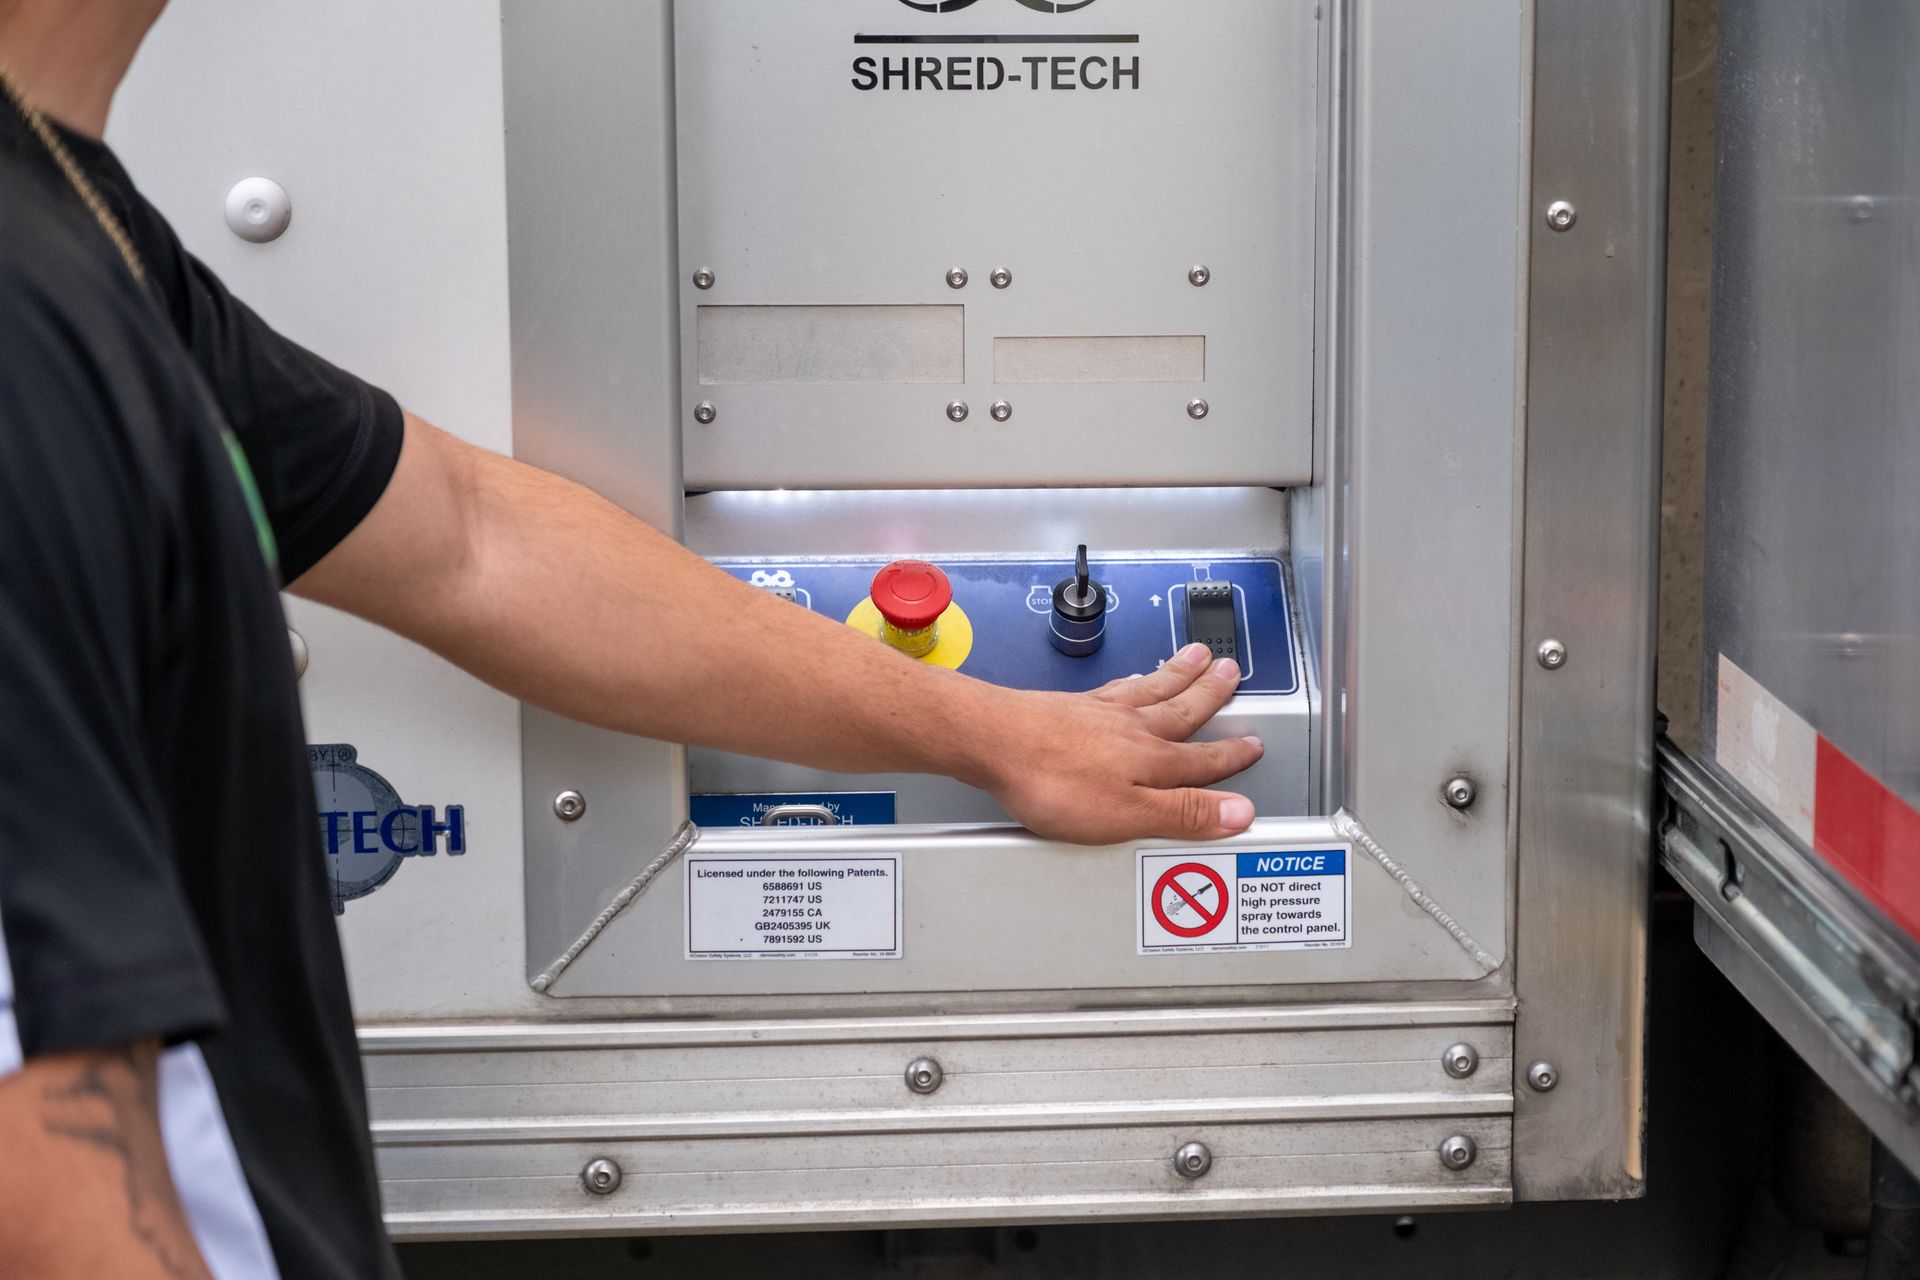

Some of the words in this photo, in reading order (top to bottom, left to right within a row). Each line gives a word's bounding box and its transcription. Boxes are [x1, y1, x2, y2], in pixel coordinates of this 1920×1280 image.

[851, 56, 1139, 90] SHRED-TECH
[1256, 856, 1326, 873] NOTICE
[697, 869, 744, 878] Licensed
[746, 869, 776, 878] under
[779, 869, 795, 878] the
[798, 868, 844, 879] following
[847, 868, 888, 877] Patents.
[762, 882, 804, 891] 6588691
[807, 882, 823, 891] US
[1241, 884, 1257, 893] Do
[1260, 883, 1286, 893] NOT
[1288, 882, 1321, 892] direct
[762, 895, 805, 904] 7211747
[807, 895, 823, 904] US
[1241, 897, 1266, 909] high
[1269, 896, 1320, 908] pressure
[762, 909, 805, 917] 2479155
[807, 909, 823, 917] CA
[1241, 912, 1273, 923] spray
[1276, 909, 1322, 920] towards
[754, 922, 813, 931] GB2405395
[815, 922, 831, 931] UK
[1241, 926, 1260, 935] the
[1262, 924, 1303, 934] control
[1306, 922, 1341, 935] panel.
[763, 935, 805, 944] 7891592
[807, 935, 823, 944] US
